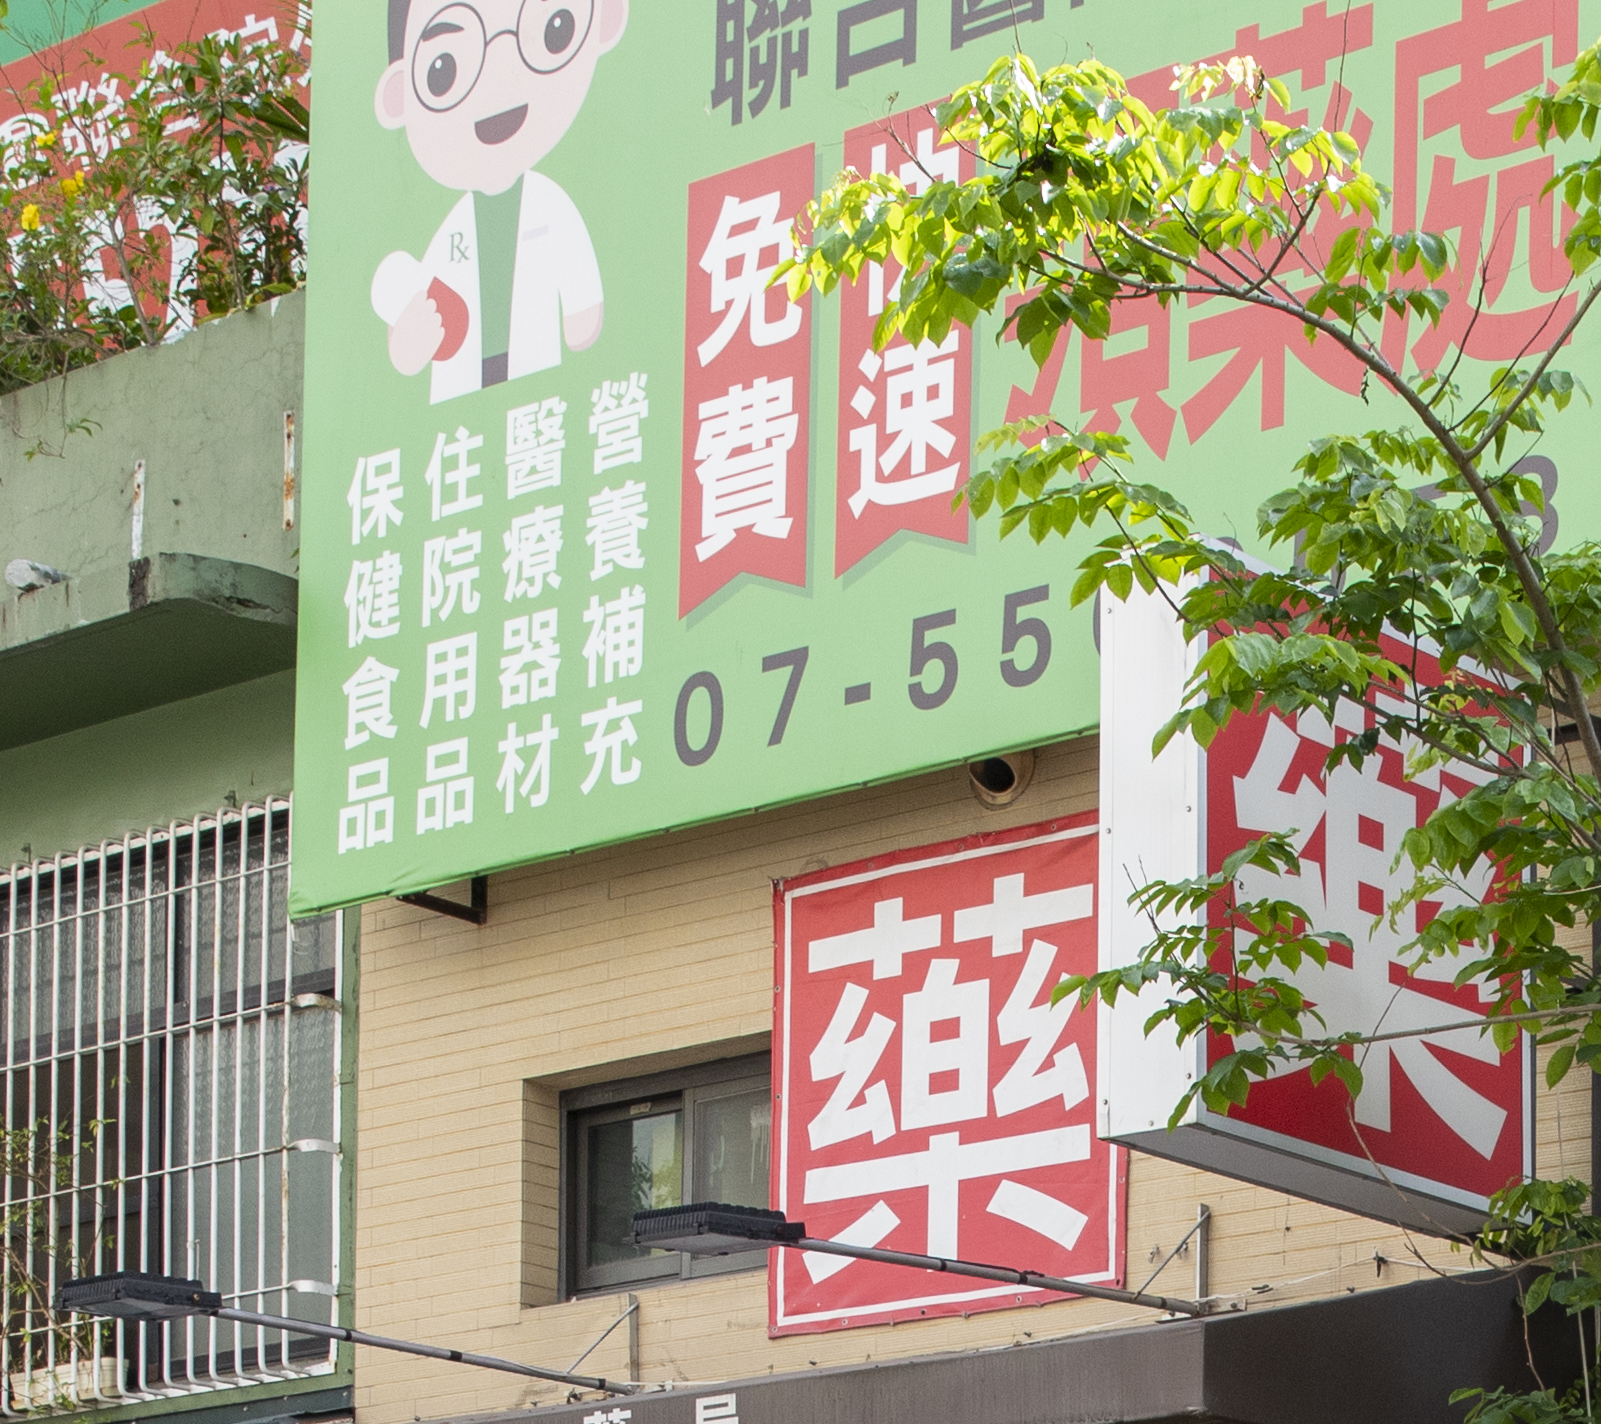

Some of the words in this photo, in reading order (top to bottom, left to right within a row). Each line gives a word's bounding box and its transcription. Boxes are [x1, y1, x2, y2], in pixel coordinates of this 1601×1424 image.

[580, 371, 650, 796] 營養補充
[694, 193, 804, 564] 免費
[337, 447, 404, 856] 保健食品
[414, 424, 484, 839] 住院用品
[495, 396, 568, 814] 醫療器材
[803, 873, 1093, 1285] 藥
